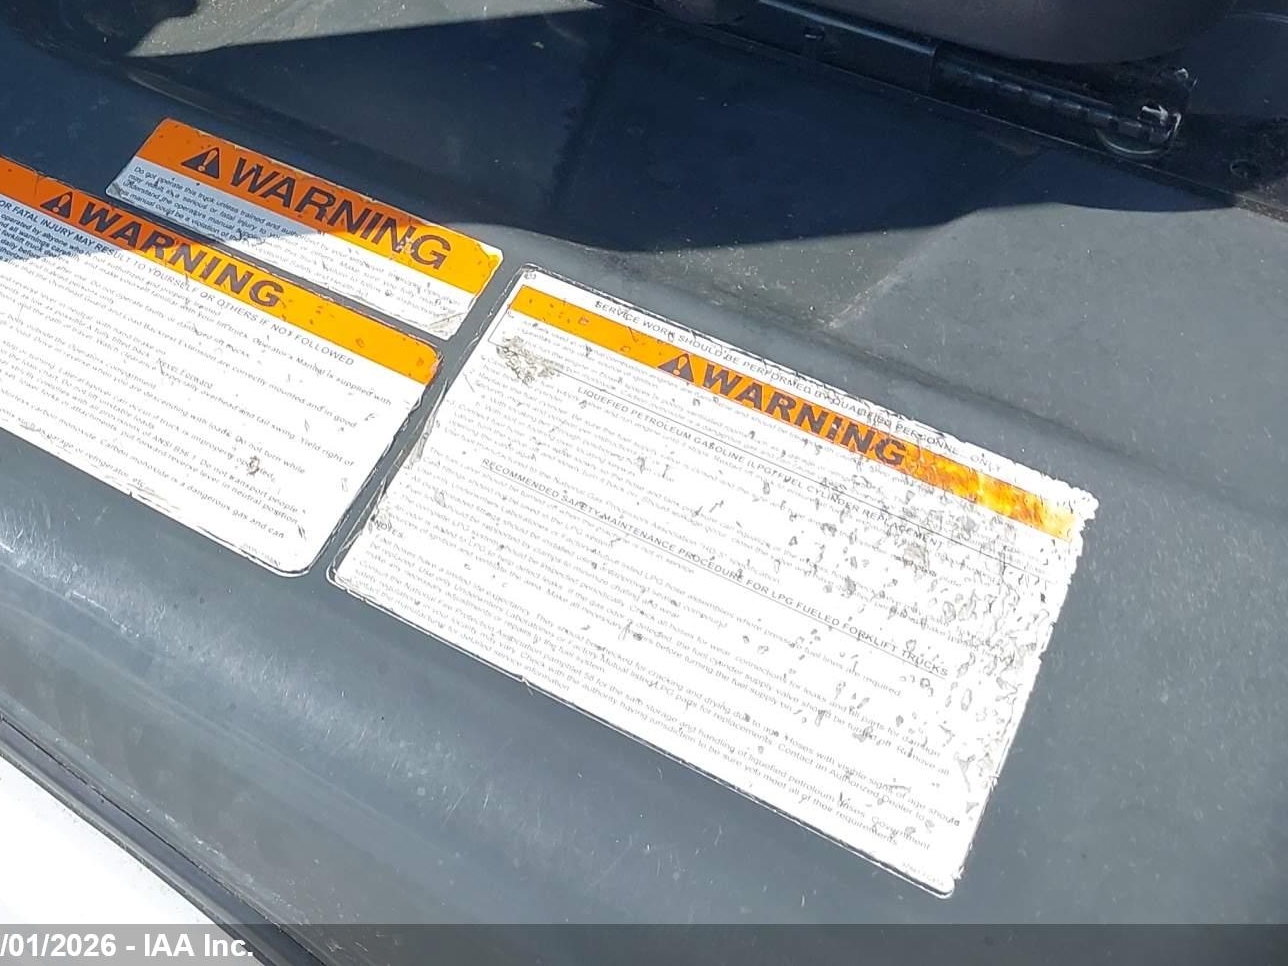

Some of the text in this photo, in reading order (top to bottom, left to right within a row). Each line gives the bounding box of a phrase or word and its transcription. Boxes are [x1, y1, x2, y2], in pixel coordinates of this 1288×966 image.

[0, 212, 32, 230] operated
[30, 226, 42, 235] by
[129, 192, 155, 206] manual
[174, 211, 185, 219] be
[219, 229, 229, 237] of
[133, 165, 281, 230] Do this unless trained and
[181, 195, 207, 210] serious
[208, 206, 218, 214] or
[218, 210, 236, 221] fatal
[236, 217, 258, 231] injury
[207, 215, 235, 230] manual
[230, 156, 453, 270] WARNING
[7, 225, 18, 233] all
[17, 230, 51, 248] warnings
[17, 246, 41, 260] before
[23, 240, 43, 252] truck
[81, 199, 286, 312] WARNING
[11, 205, 40, 222] FATAL
[39, 218, 73, 237] INJURY
[72, 233, 96, 247] MAY
[94, 243, 131, 263] RESULT
[132, 260, 148, 271] TO
[146, 266, 197, 293] YOURSELF
[198, 290, 216, 302] OR
[215, 297, 259, 321] OTHERS
[258, 317, 268, 326] IF
[270, 322, 293, 337] NOT
[294, 333, 356, 365] FOLLOWED
[594, 300, 640, 324] SERVICE
[641, 320, 677, 339] WORK
[677, 334, 722, 358] SHOULD
[724, 354, 740, 365] BE
[744, 361, 812, 395] PERFORMED
[700, 360, 910, 470] WARNING
[576, 386, 629, 413] LIQUEFIED
[629, 408, 691, 440] PETROLEUM
[693, 436, 745, 463] GASOLINE
[805, 483, 859, 513] CYLINDER
[861, 507, 943, 549] REPLACEMENT
[266, 525, 285, 539] can
[481, 457, 949, 677] RECOMMENDED SAFETY MAINTENANCE PROCEDURE FOR LPG FUELED FORKLIFT TRUCKS
